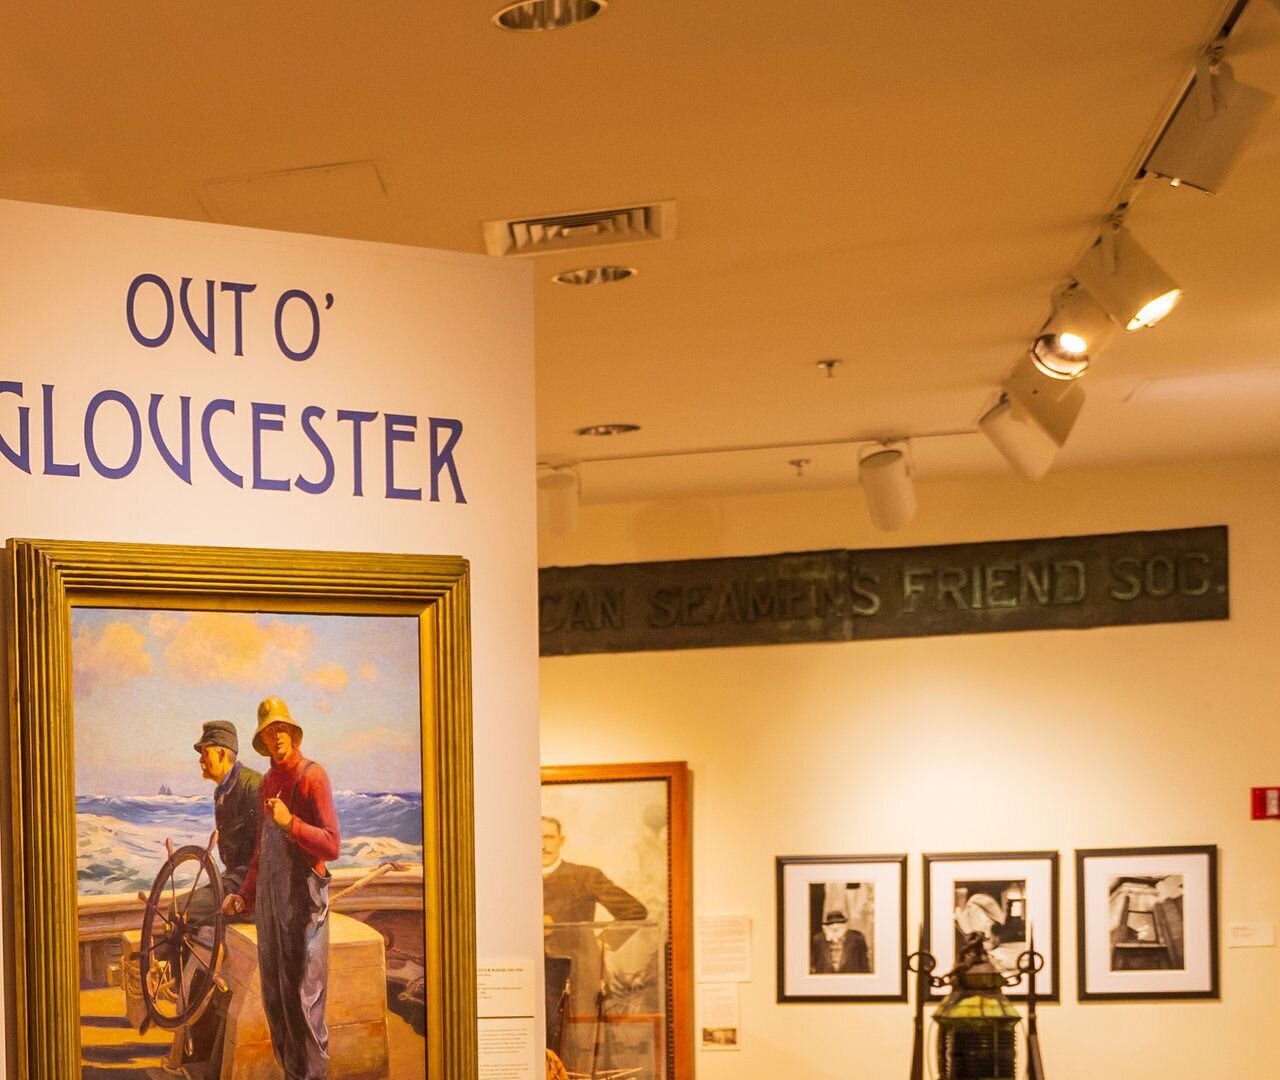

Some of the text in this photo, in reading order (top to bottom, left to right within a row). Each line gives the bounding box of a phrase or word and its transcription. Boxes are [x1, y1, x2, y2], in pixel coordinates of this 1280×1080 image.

[125, 272, 336, 362] OUT O'
[902, 560, 1086, 615] FRIEND
[1110, 552, 1226, 601] SOC.
